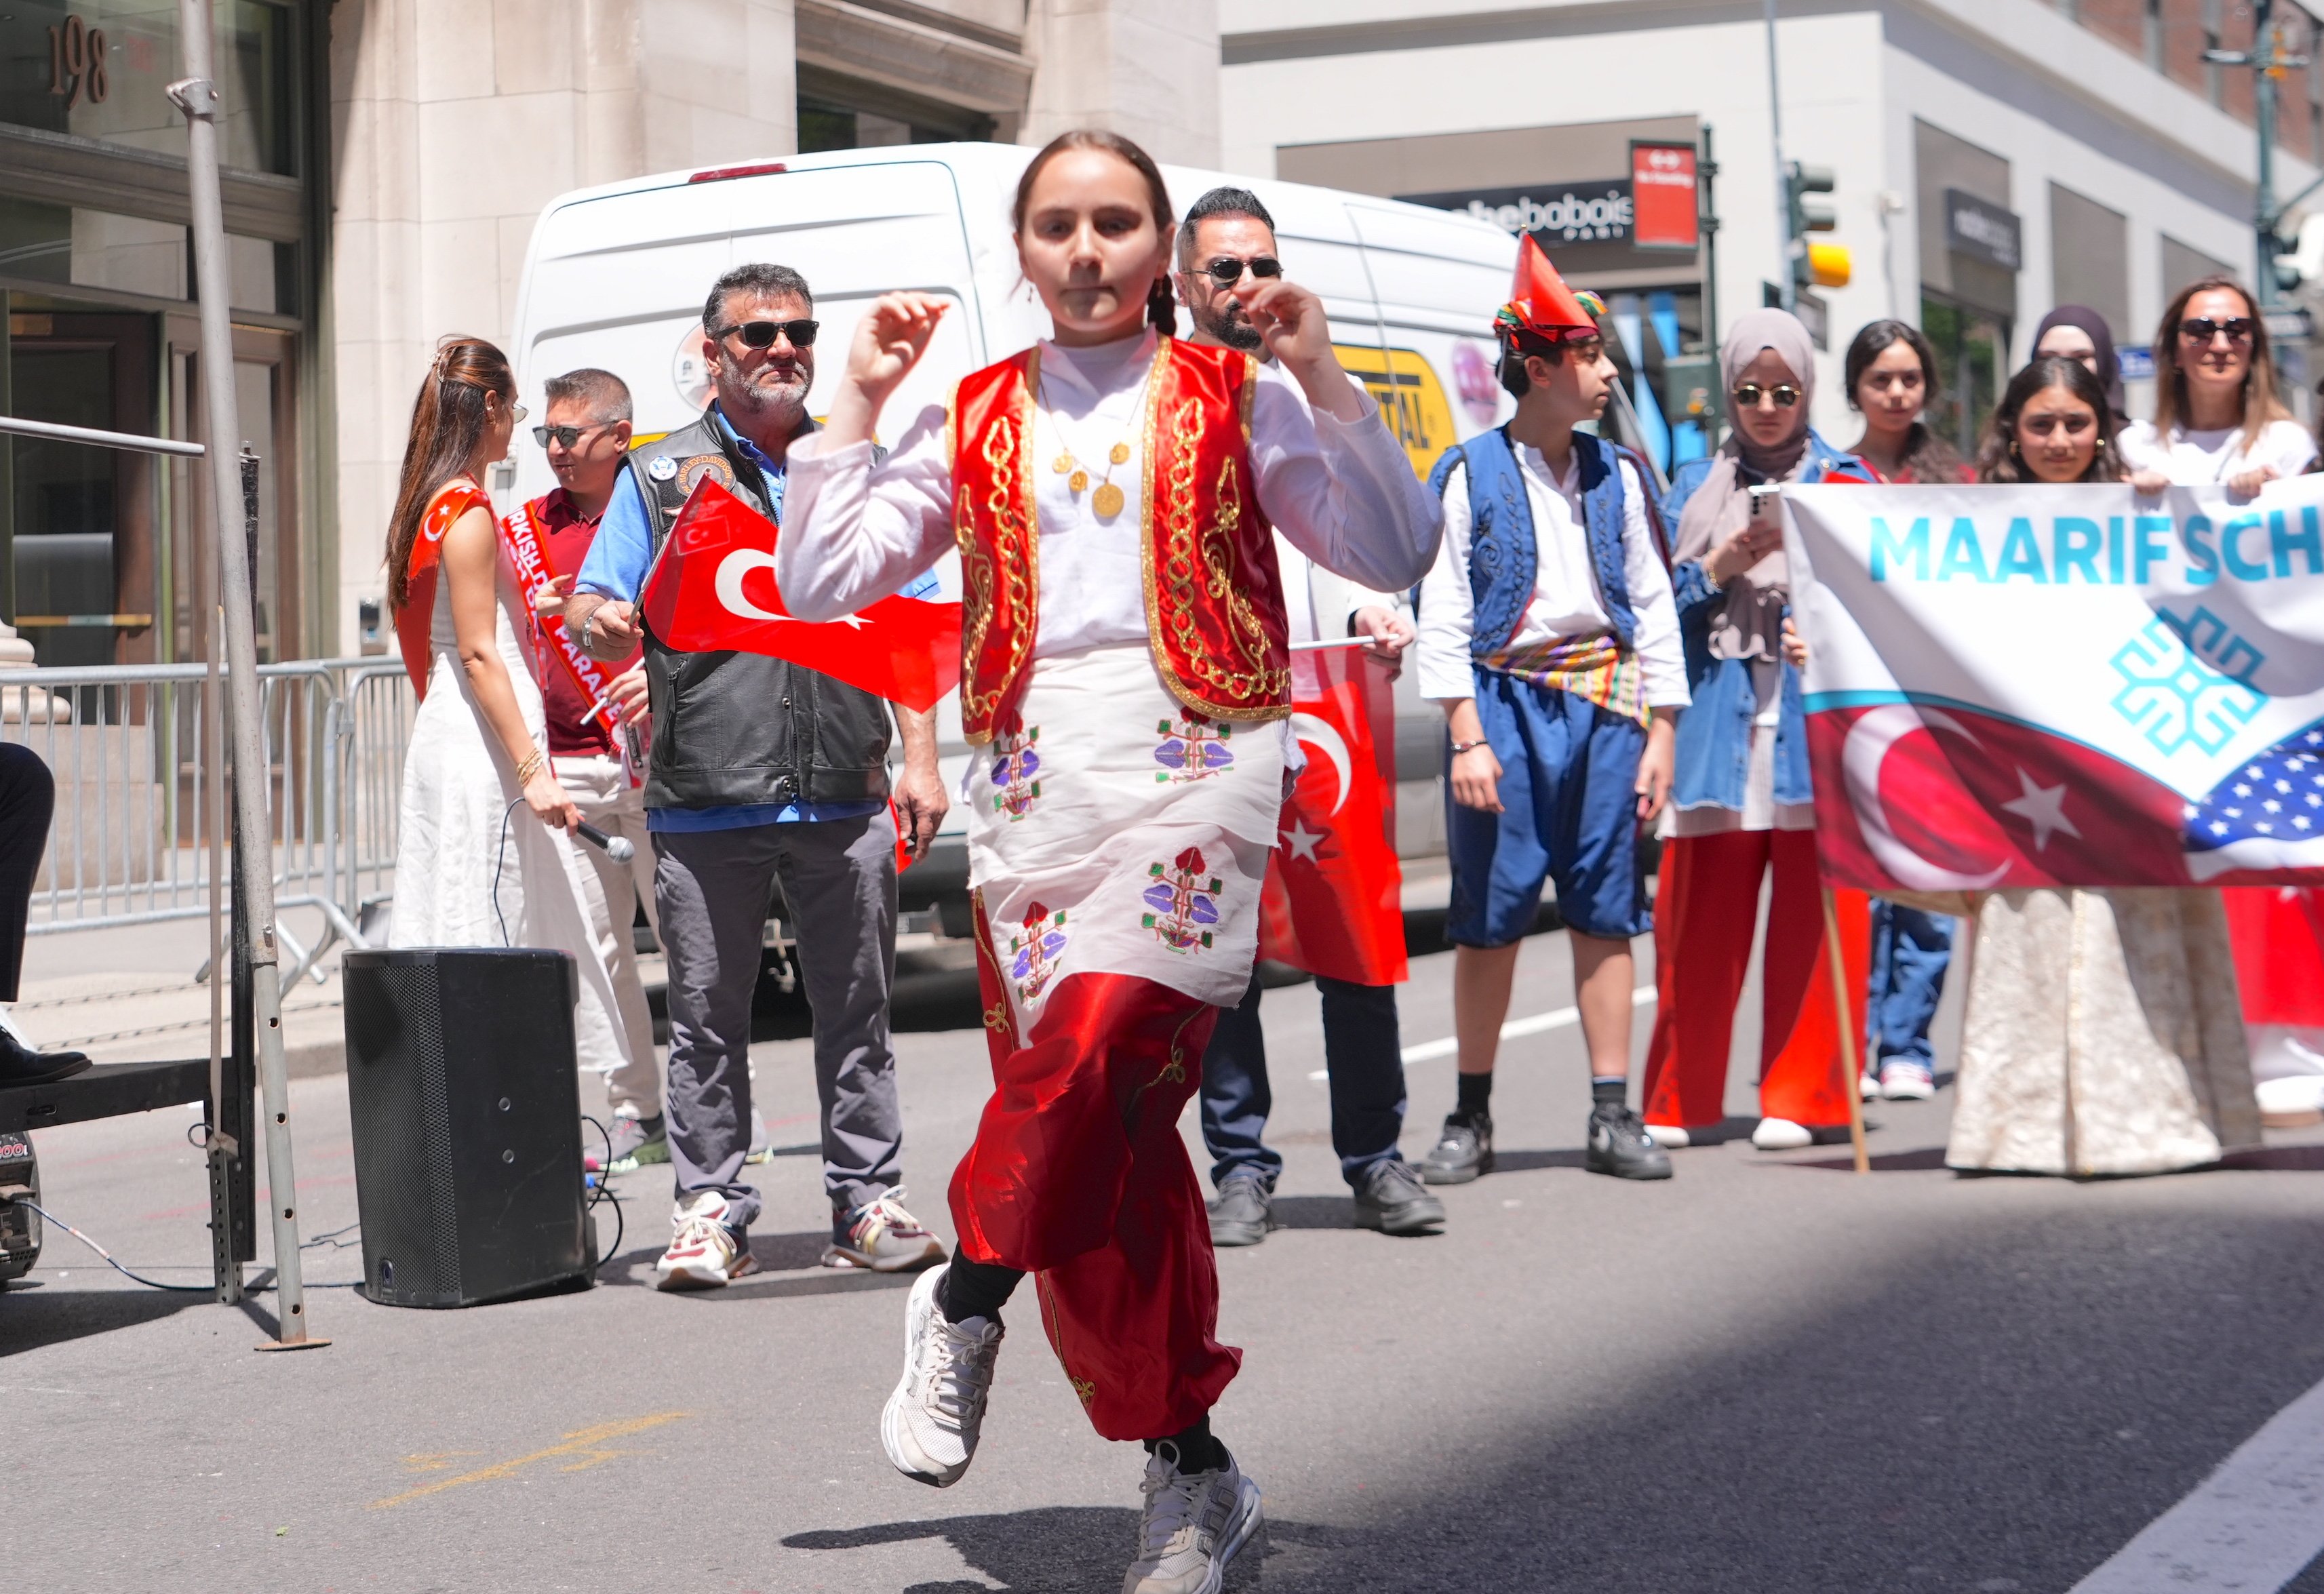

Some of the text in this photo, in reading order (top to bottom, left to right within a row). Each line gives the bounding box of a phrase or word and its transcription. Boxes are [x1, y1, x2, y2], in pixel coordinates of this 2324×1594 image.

[47, 14, 109, 111] 198
[679, 455, 732, 484] HARLEY-DAVIDSON
[507, 506, 542, 570] RKISH
[1870, 506, 2324, 586] MAARIF SCH
